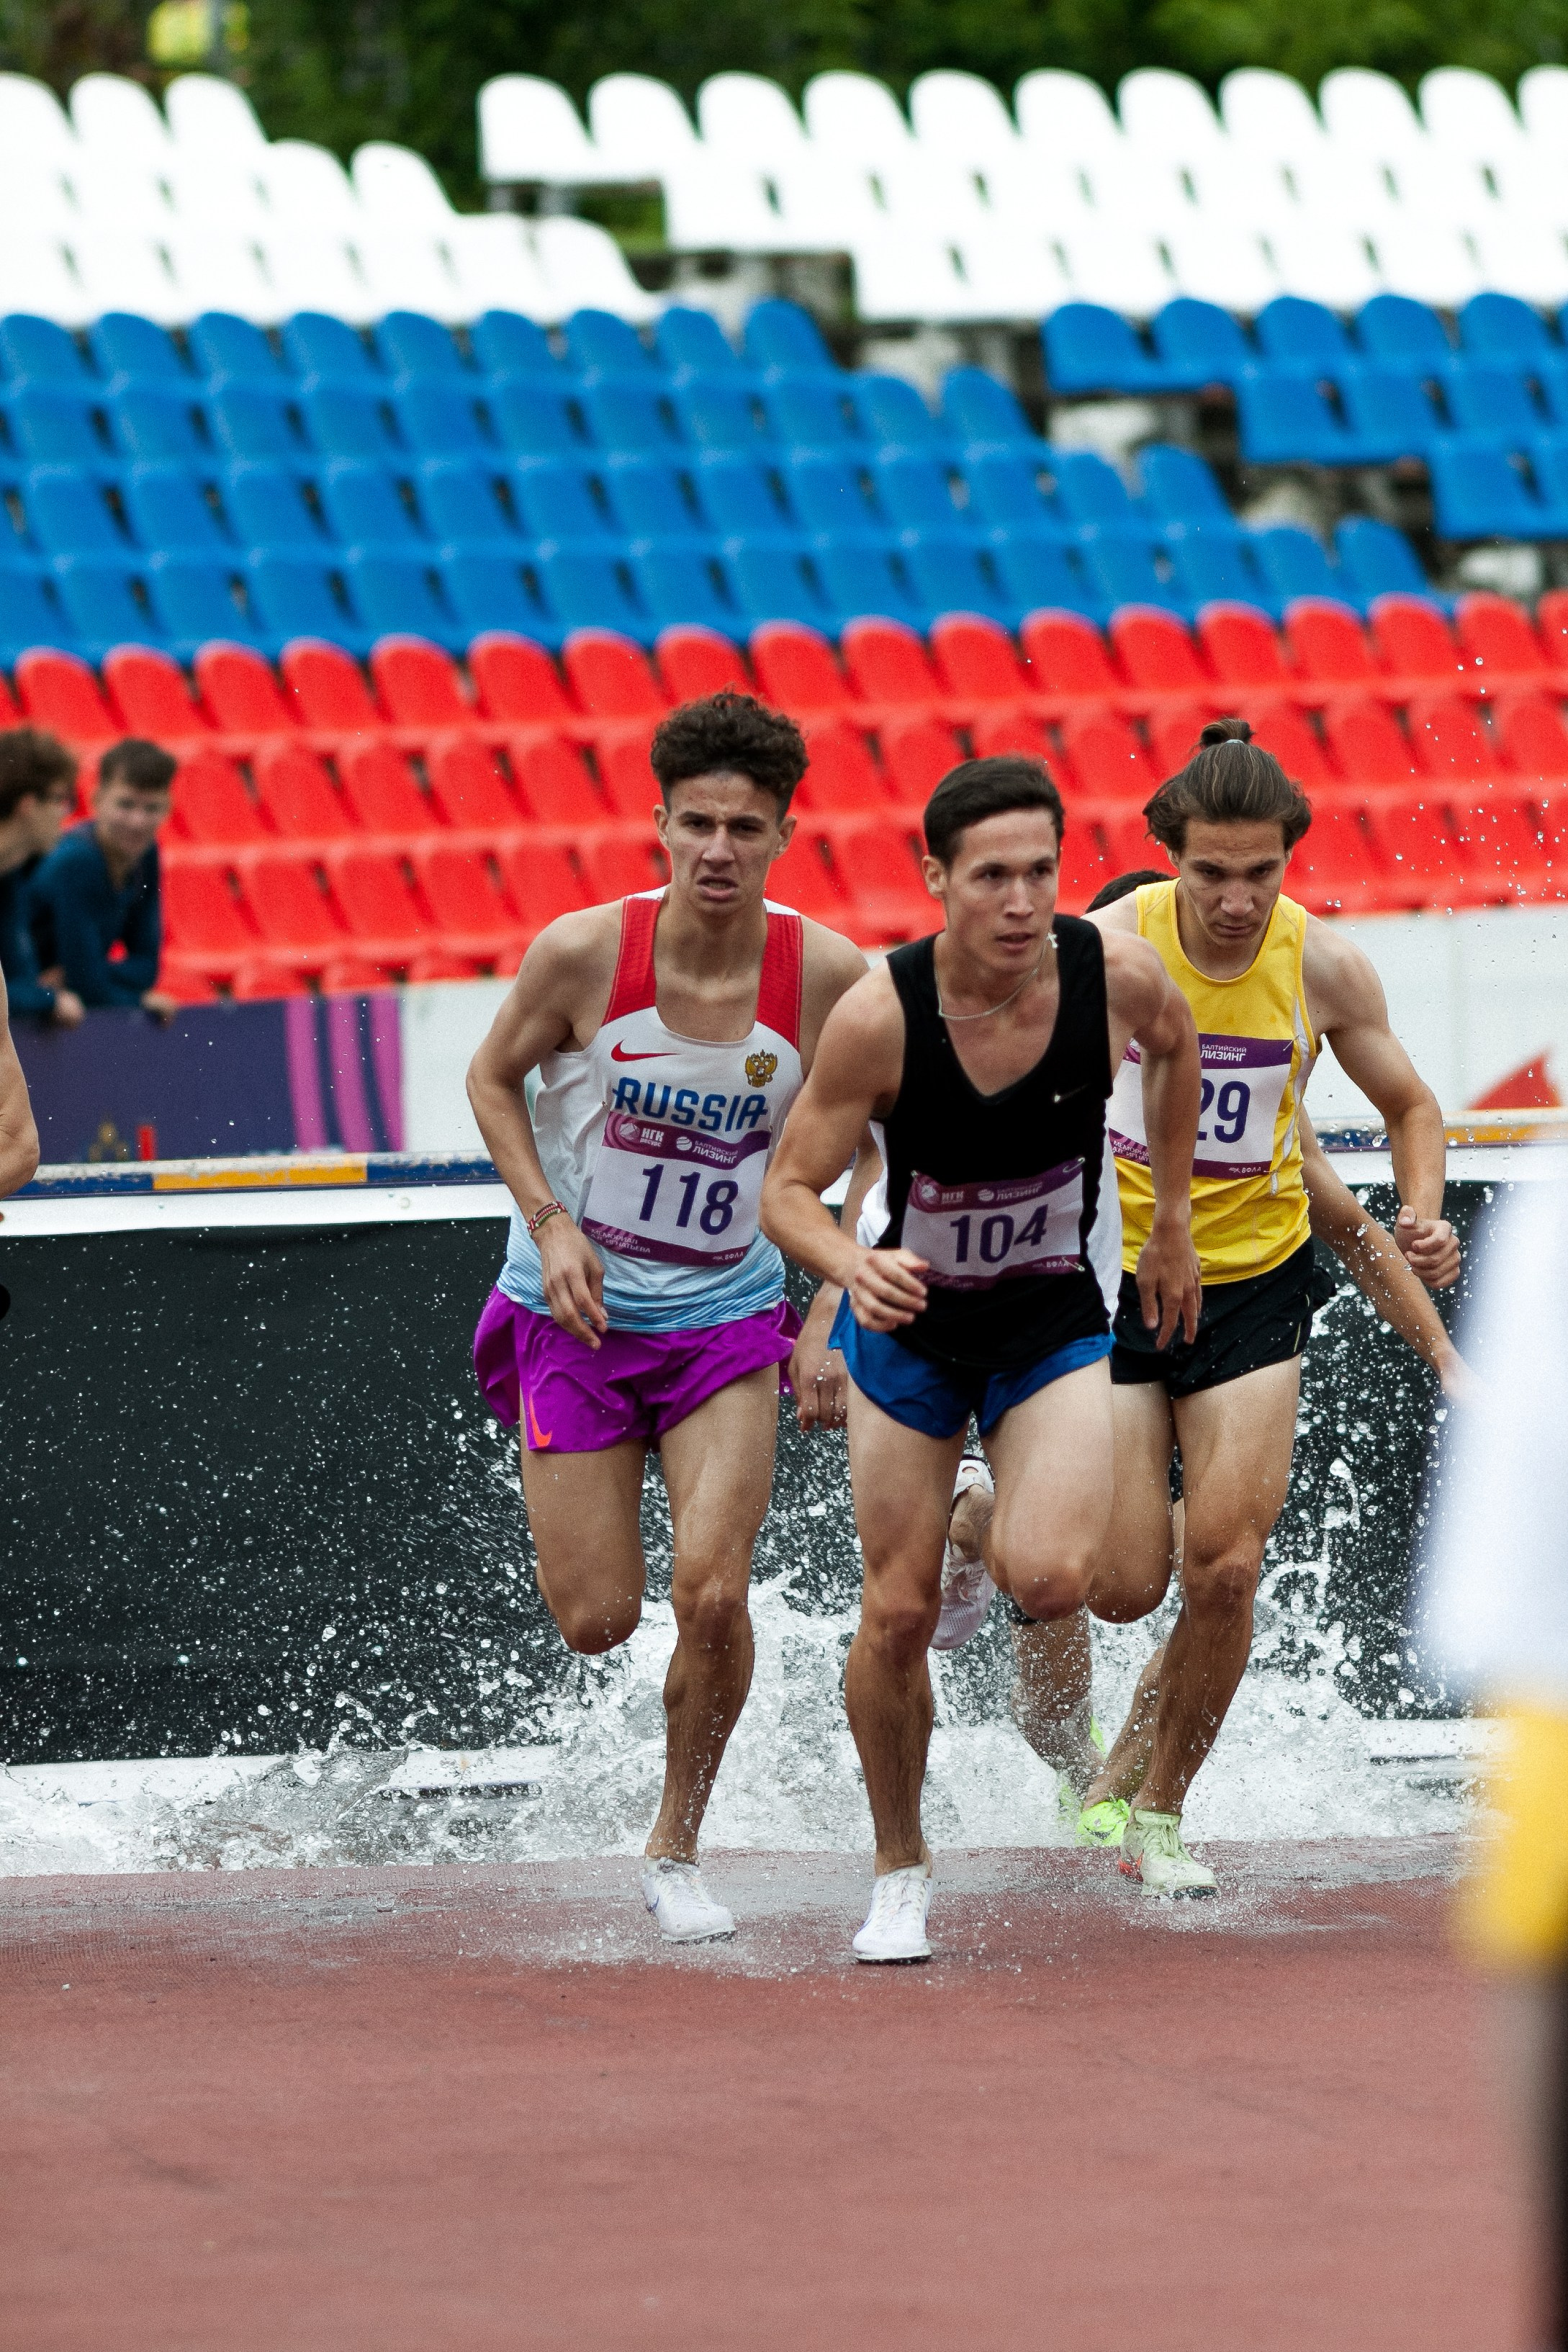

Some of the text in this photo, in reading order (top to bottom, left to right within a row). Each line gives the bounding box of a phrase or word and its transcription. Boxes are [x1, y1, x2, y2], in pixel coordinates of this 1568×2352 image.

[1200, 1050, 1246, 1062] ЛИЗИНГ
[1202, 1044, 1247, 1053] БАЛТИЙСКИЙ
[613, 1077, 768, 1132] RUSSIA
[693, 1145, 737, 1163] ЛИЗИНГ
[695, 1140, 738, 1156] БАЛТИЙСКИЙ
[639, 1164, 739, 1235] 118
[591, 1228, 638, 1244] МЕМОРИАЛ
[950, 1204, 1048, 1263] 104
[724, 1251, 744, 1260] ВФЛА
